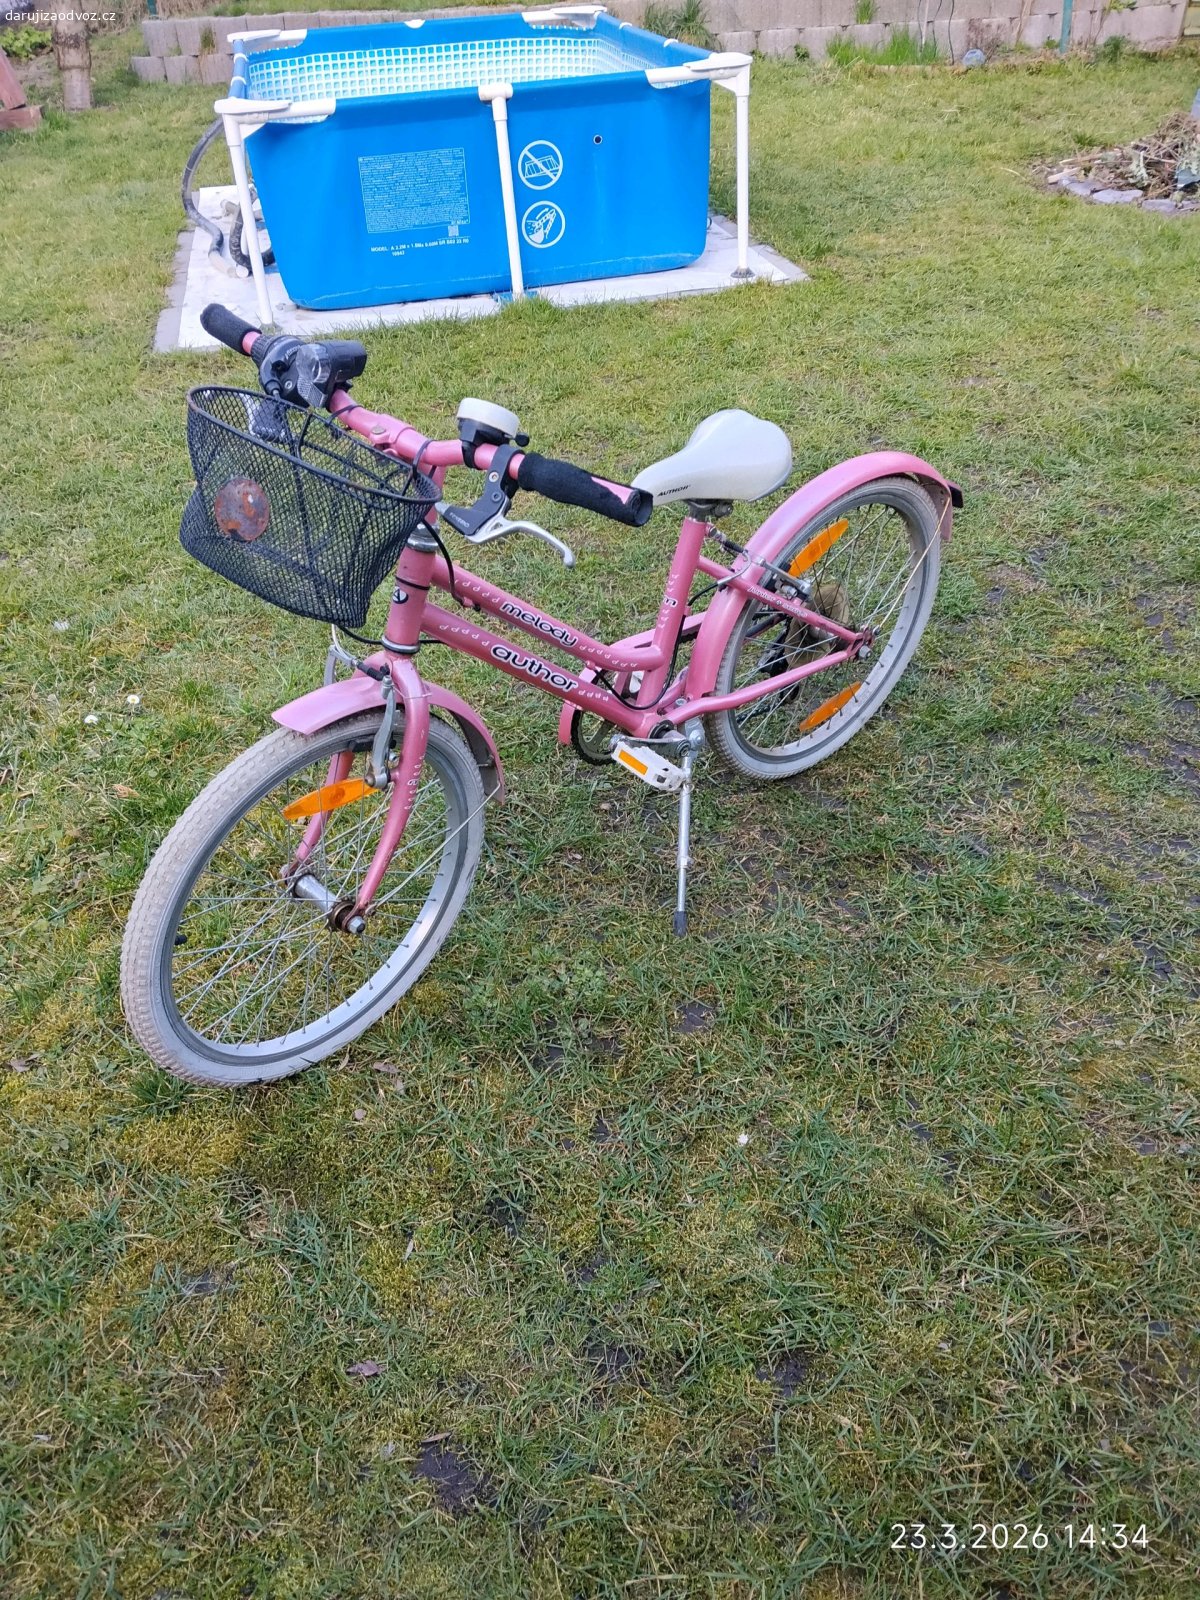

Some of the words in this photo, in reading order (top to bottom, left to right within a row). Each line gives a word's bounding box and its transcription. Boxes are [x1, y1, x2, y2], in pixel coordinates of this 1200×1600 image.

[657, 485, 689, 497] AUTHOR
[499, 601, 578, 647] melody
[491, 644, 578, 692] author
